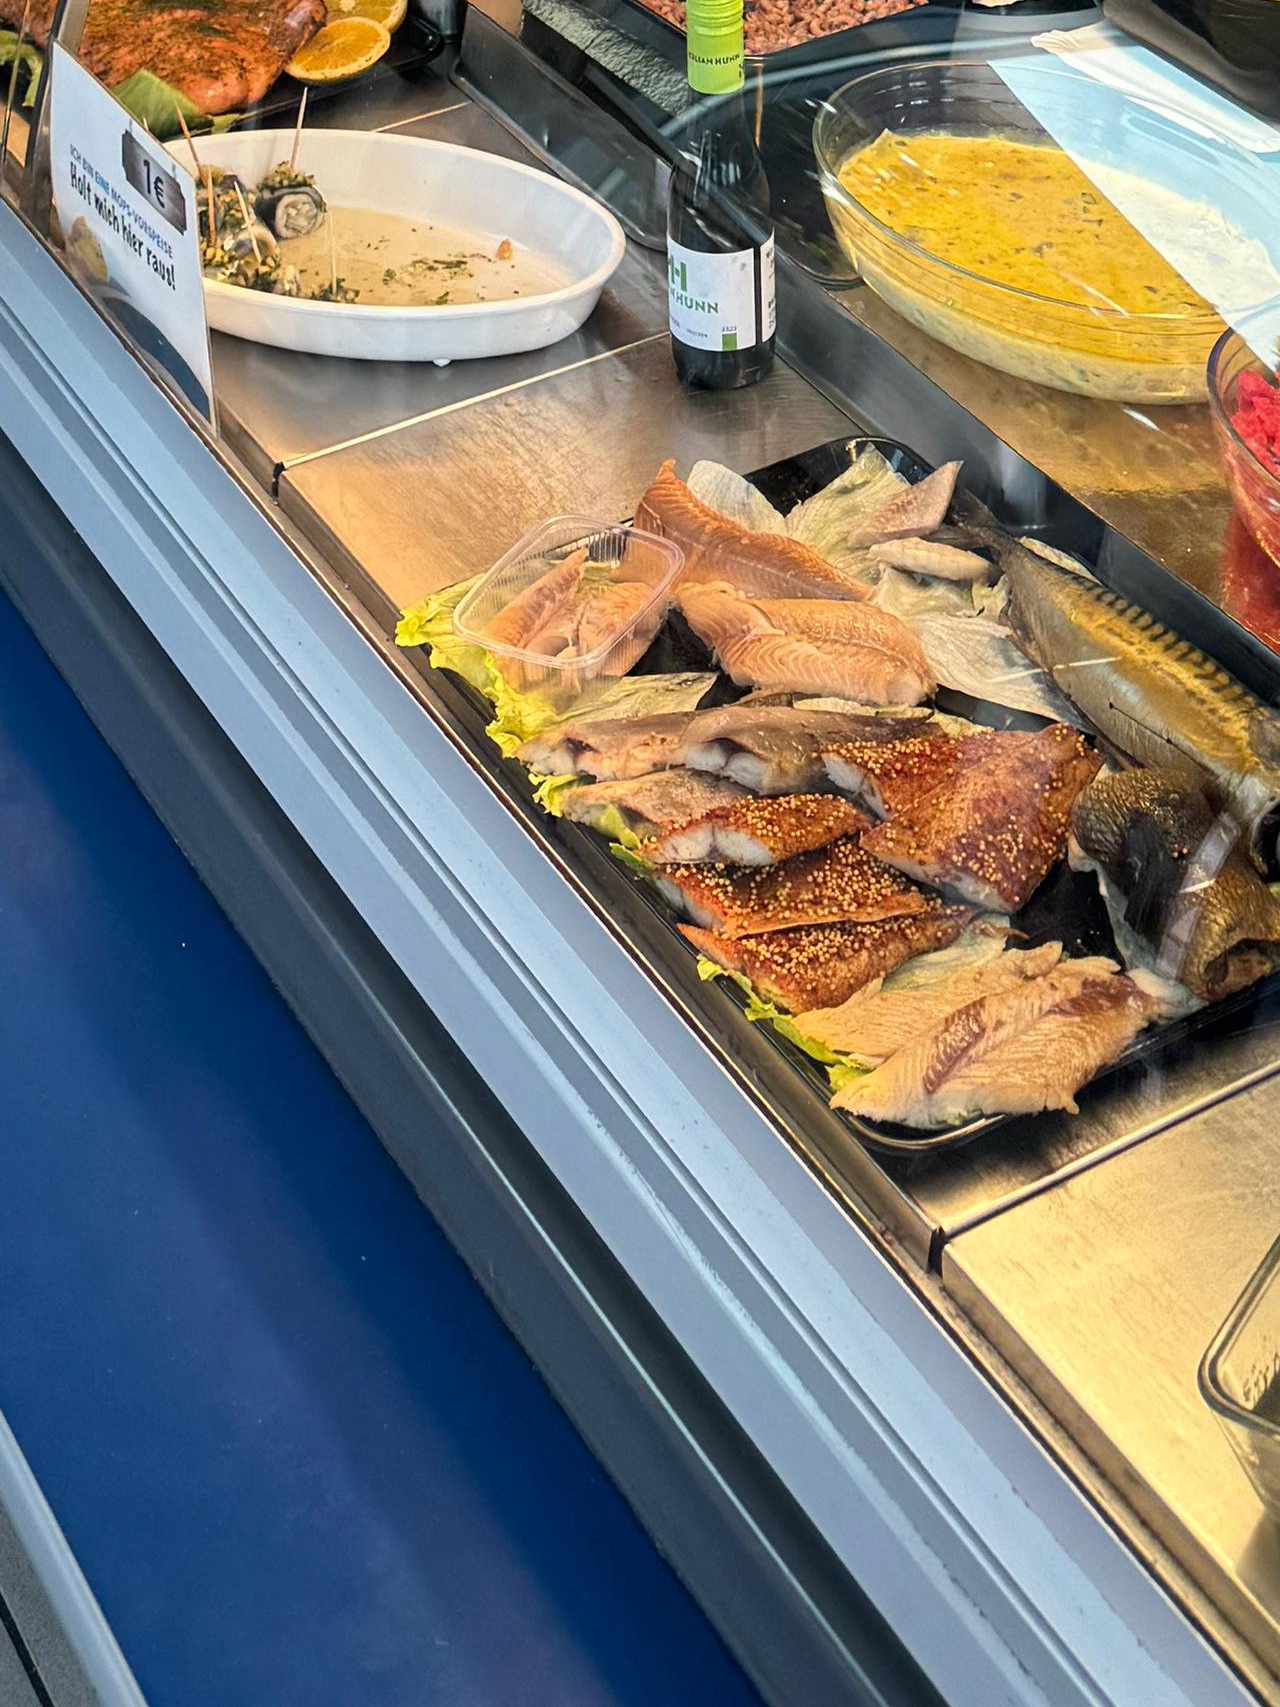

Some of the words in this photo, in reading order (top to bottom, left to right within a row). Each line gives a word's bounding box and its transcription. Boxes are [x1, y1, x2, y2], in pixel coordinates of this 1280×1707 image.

[70, 161, 92, 207] Holt
[94, 193, 120, 235] mich
[121, 215, 143, 258] hier
[145, 247, 177, 292] raus!
[82, 155, 94, 180] BIN
[94, 166, 110, 196] EINE
[111, 187, 174, 260] MOPS-VORSPEISE
[675, 291, 719, 315] HUNN
